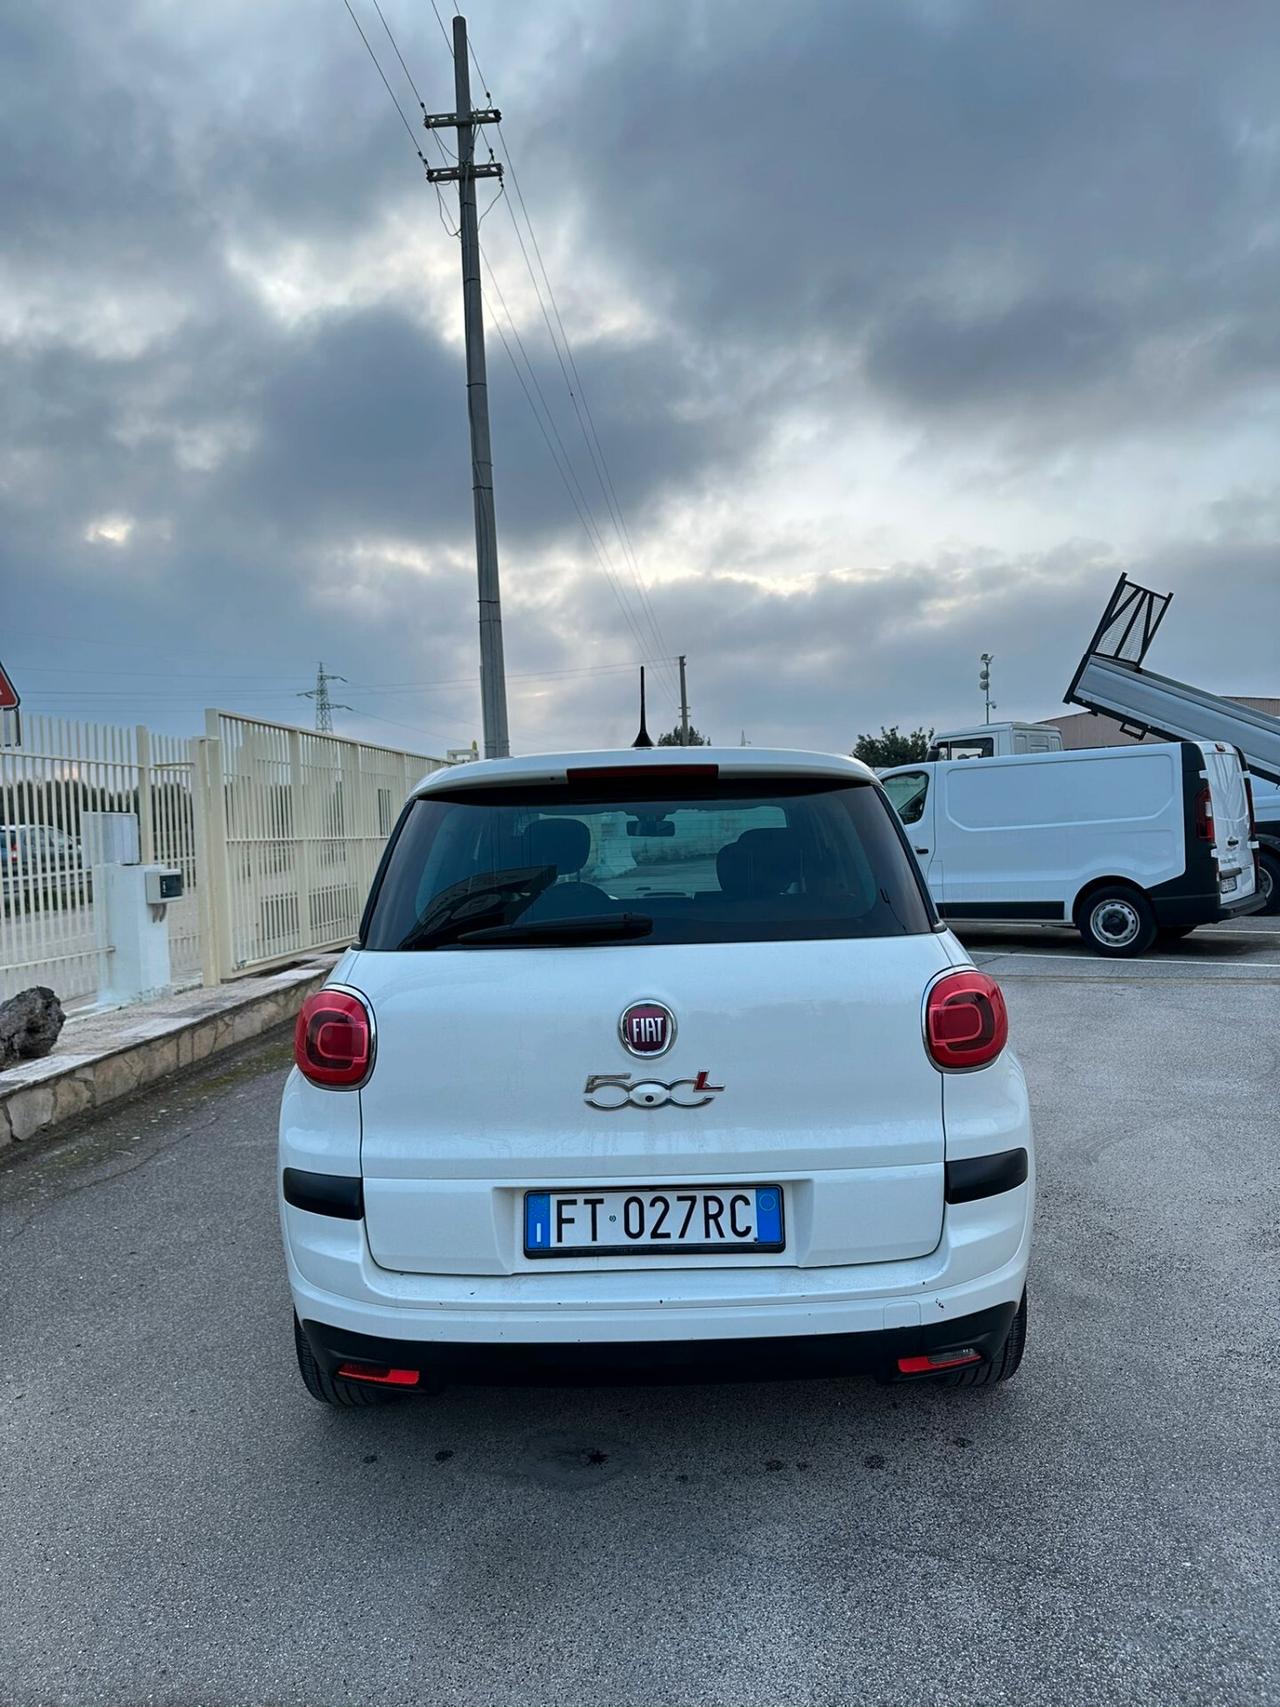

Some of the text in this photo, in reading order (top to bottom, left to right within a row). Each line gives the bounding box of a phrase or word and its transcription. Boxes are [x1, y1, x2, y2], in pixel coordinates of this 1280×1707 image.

[632, 1017, 664, 1043] FIAT
[583, 1069, 727, 1111] 500L
[556, 1195, 752, 1243] FT 027RC
